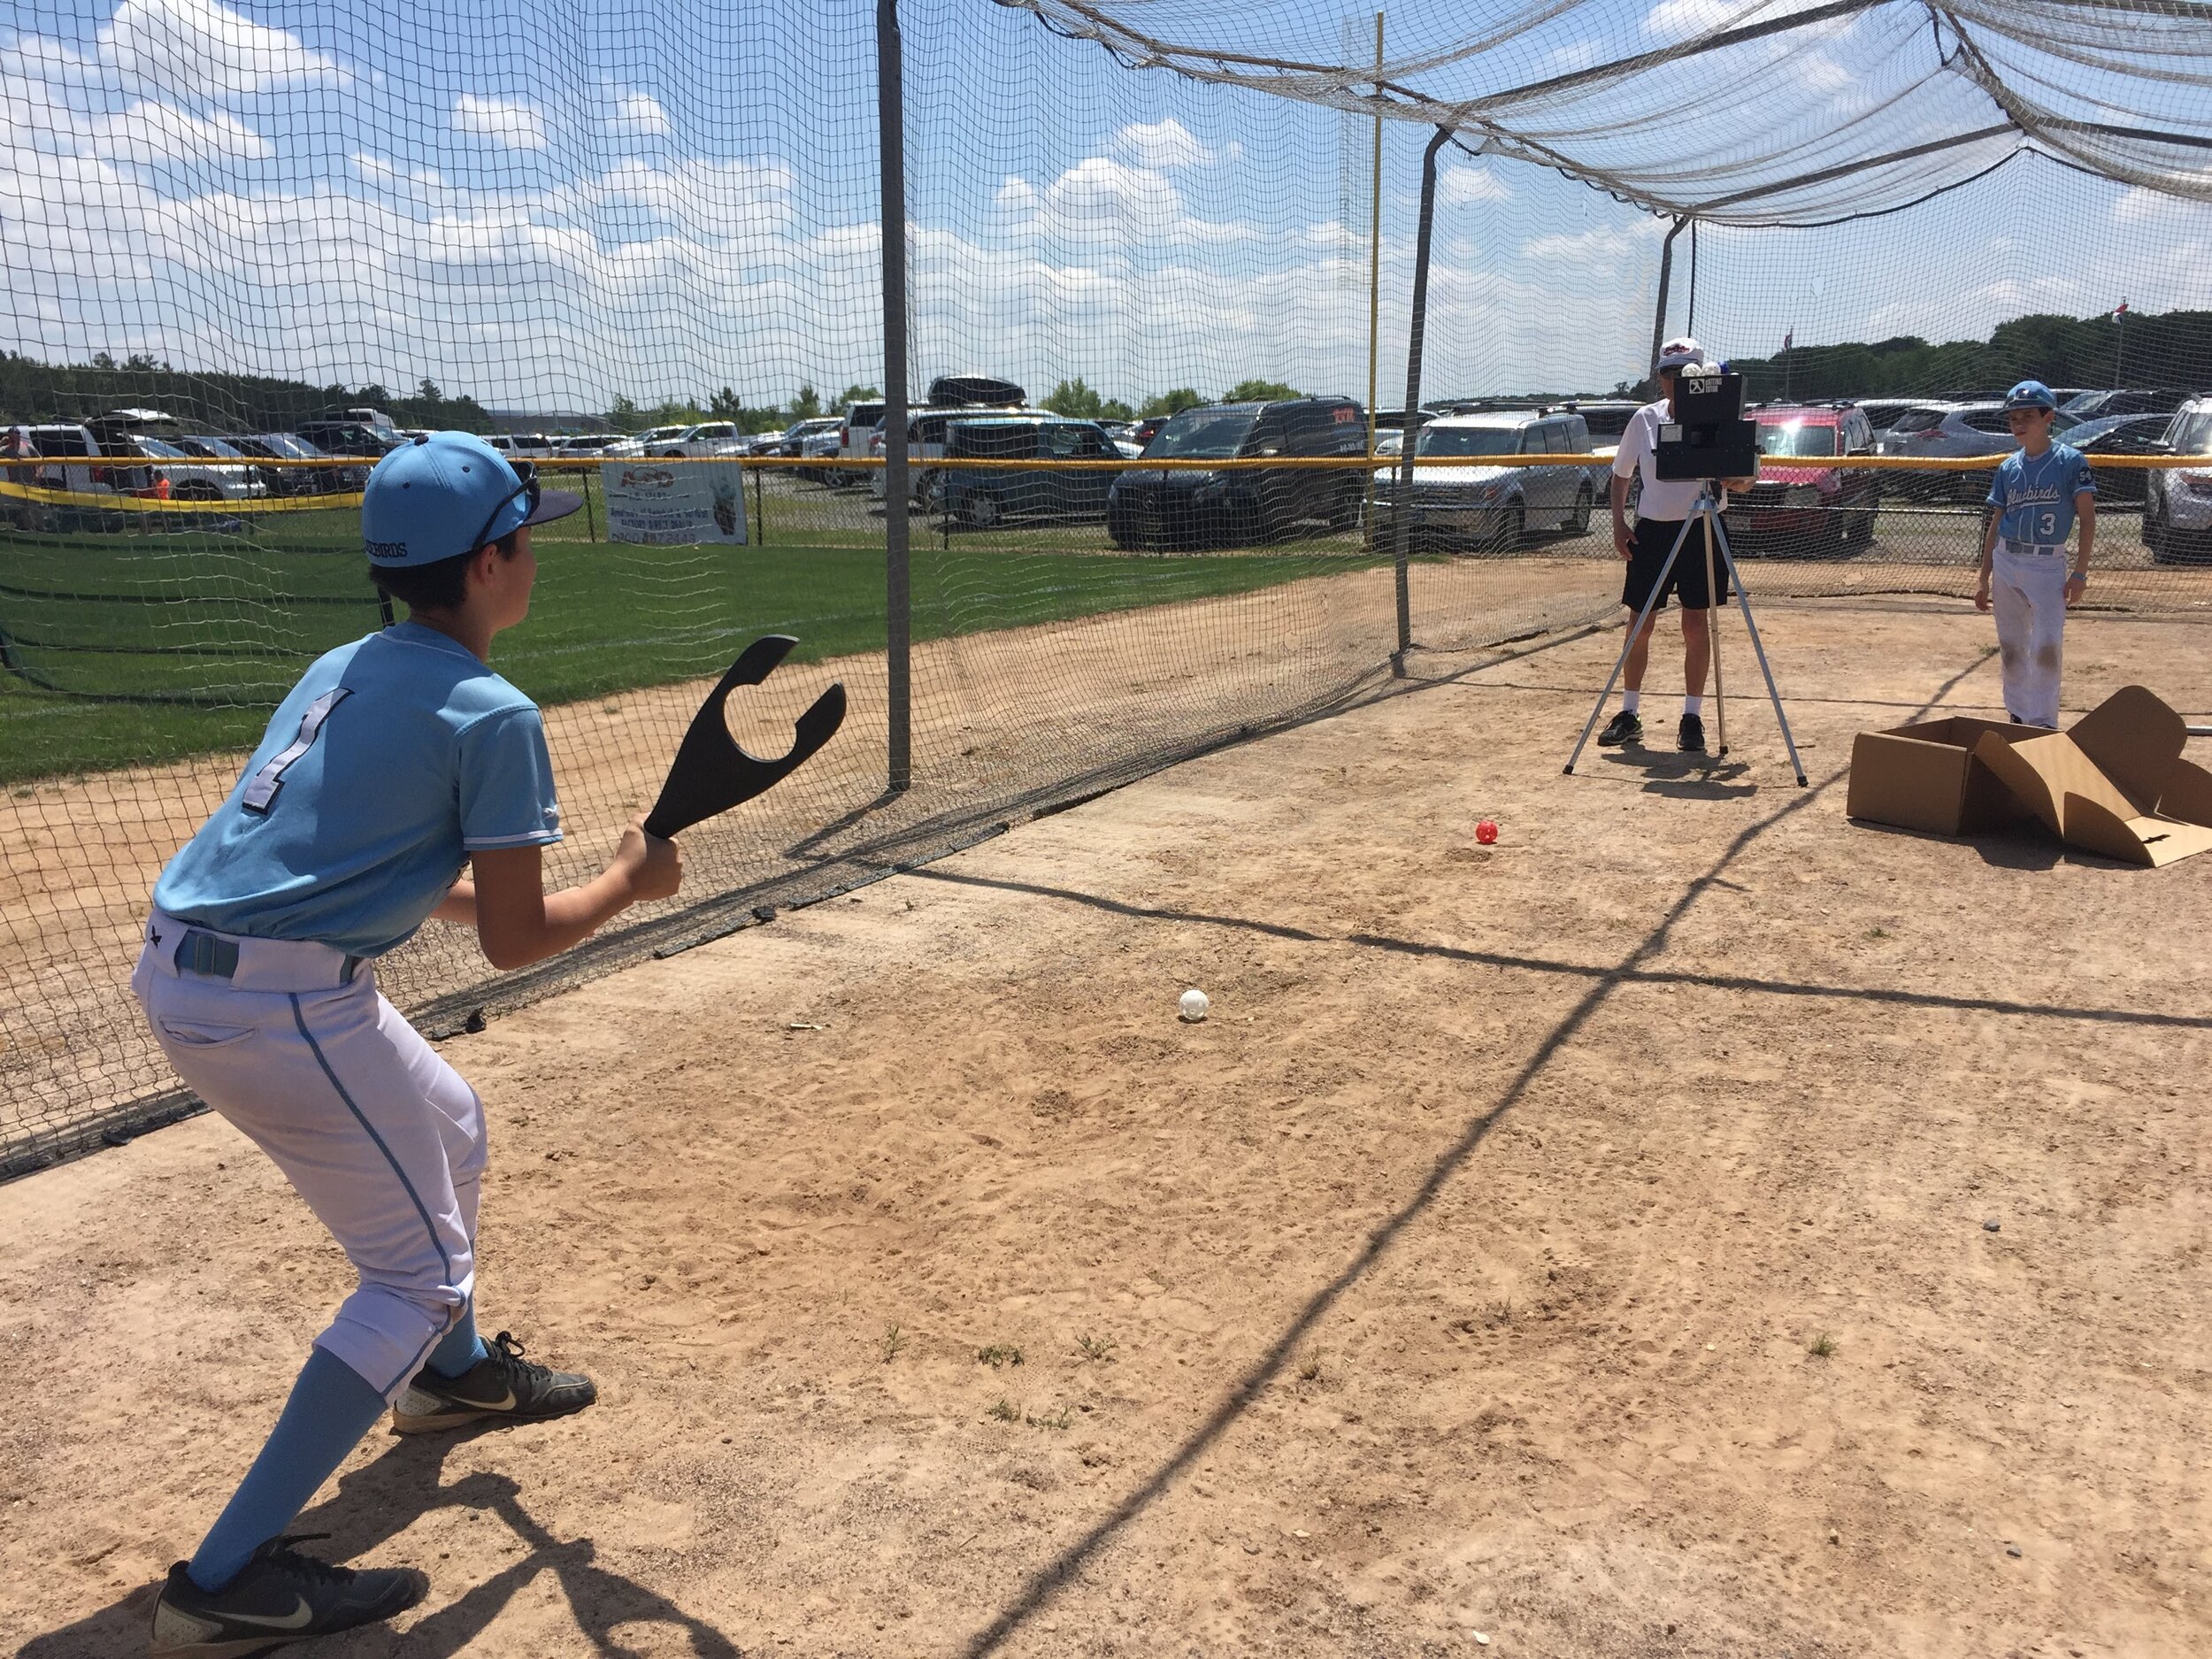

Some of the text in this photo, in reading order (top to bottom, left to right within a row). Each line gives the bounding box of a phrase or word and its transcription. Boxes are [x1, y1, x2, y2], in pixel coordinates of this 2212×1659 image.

[2007, 483, 2060, 506] Bluebirds
[2039, 513, 2055, 535] 3
[241, 687, 356, 815] 1
